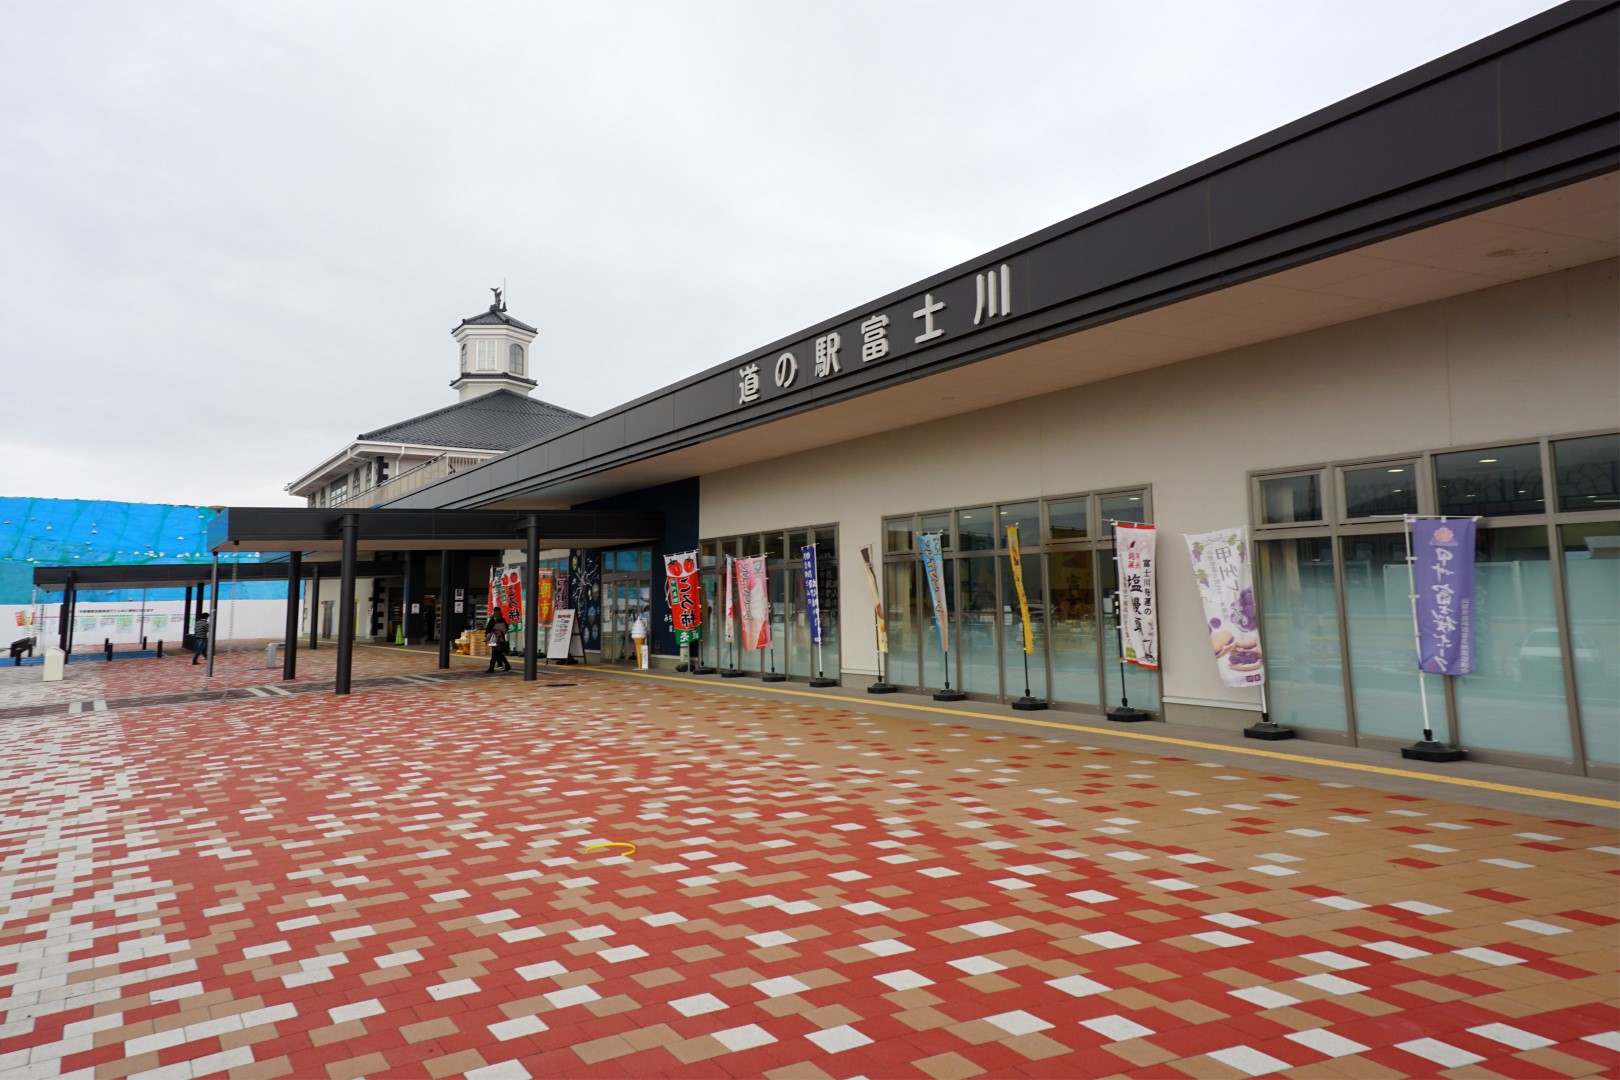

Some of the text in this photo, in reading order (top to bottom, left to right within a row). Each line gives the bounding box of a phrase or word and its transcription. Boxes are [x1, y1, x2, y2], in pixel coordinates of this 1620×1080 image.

[738, 264, 1011, 404] 道の駅富士川
[540, 580, 552, 621] 朝市
